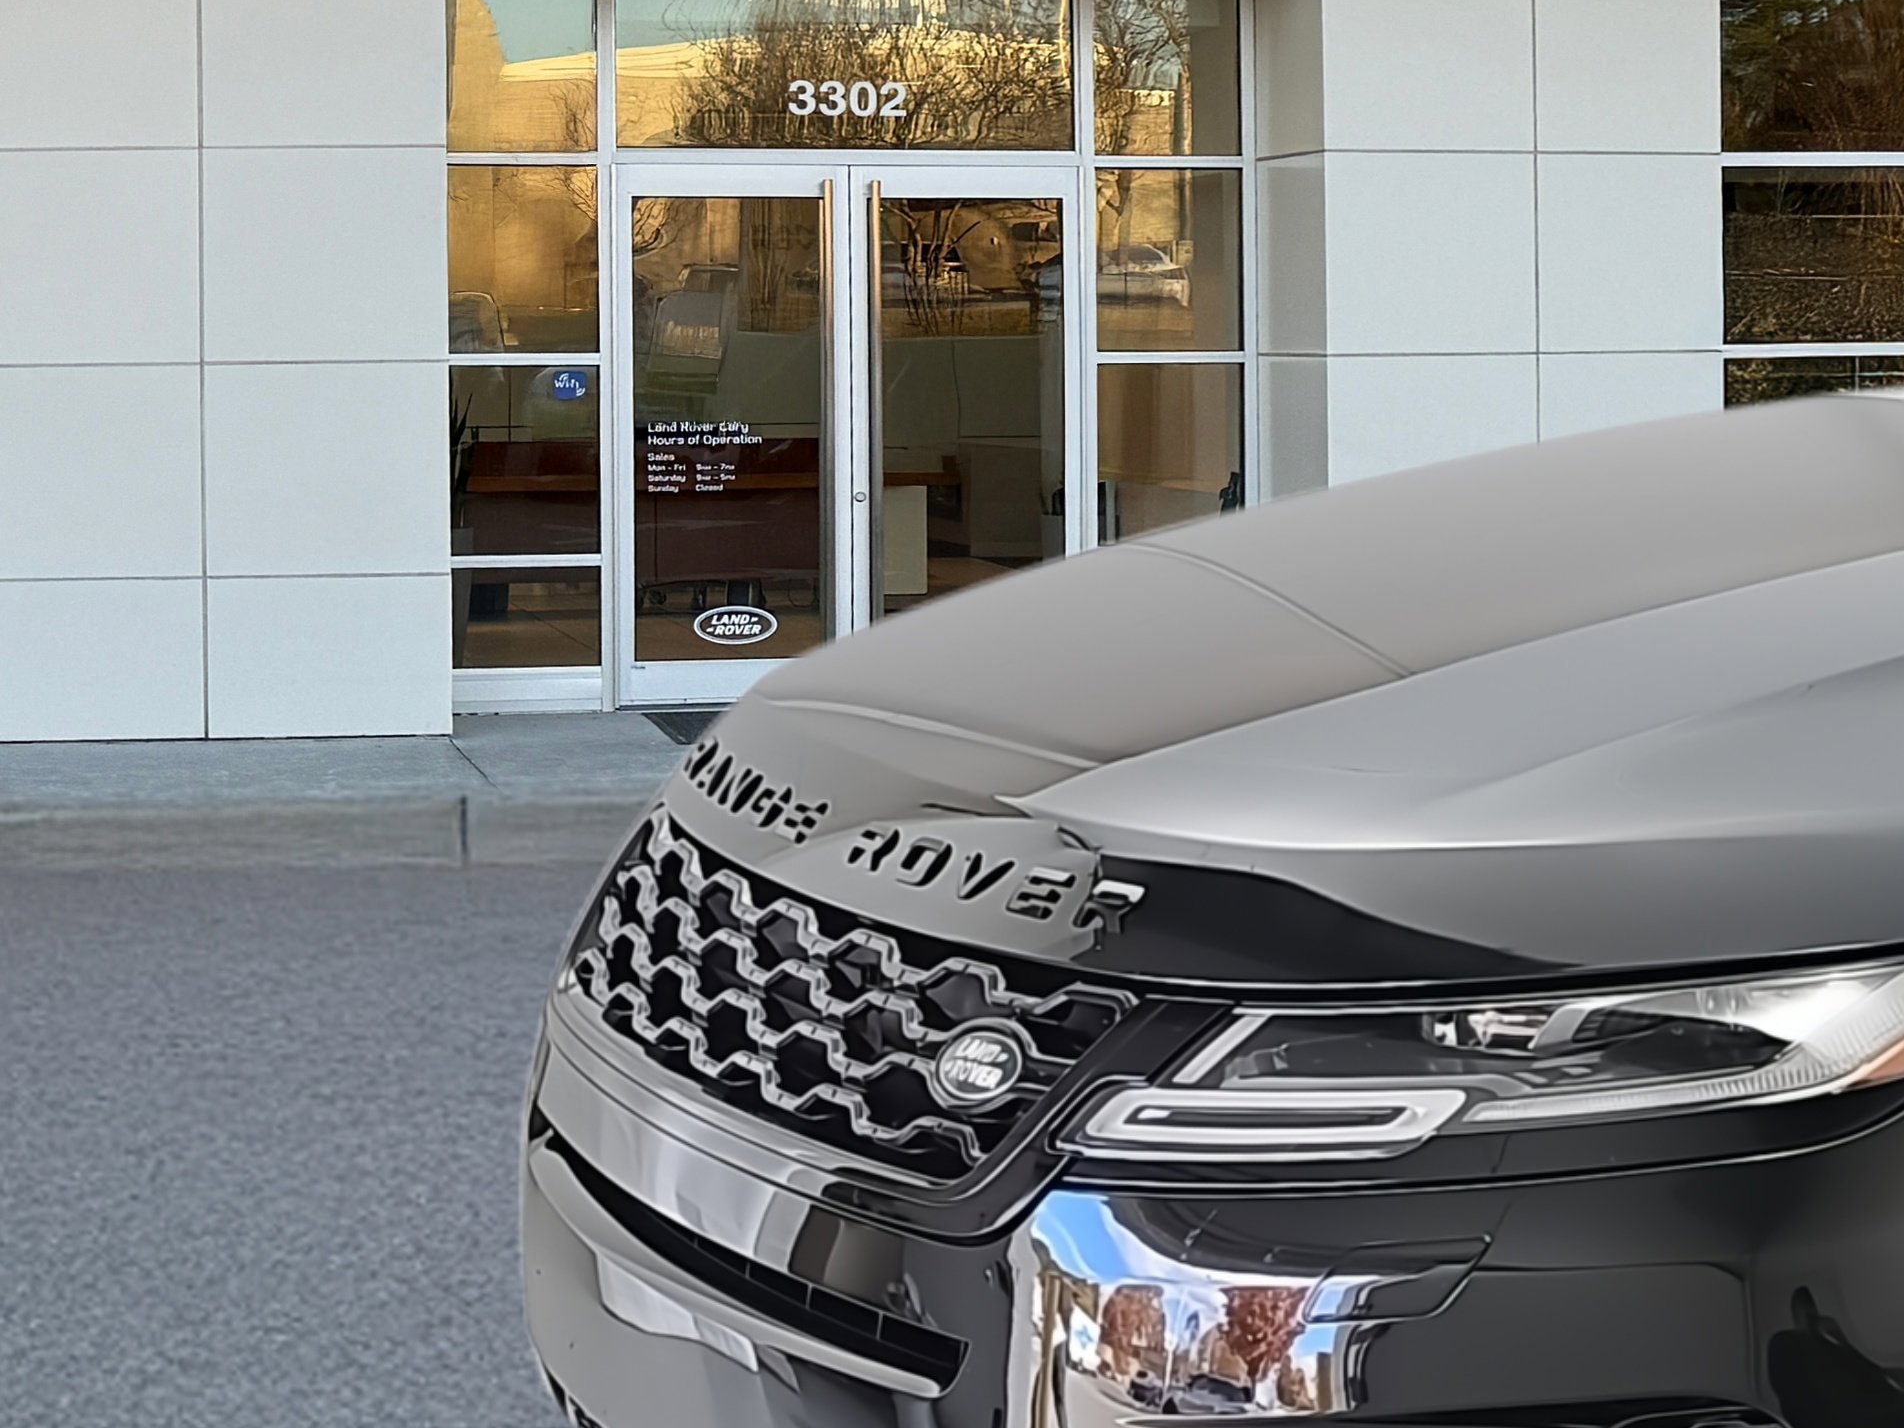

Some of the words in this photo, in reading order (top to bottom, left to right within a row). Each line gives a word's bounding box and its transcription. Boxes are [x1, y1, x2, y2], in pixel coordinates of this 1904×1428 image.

[788, 79, 908, 117] 3302
[647, 421, 678, 433] Land
[680, 421, 717, 433] Rover
[647, 435, 685, 446] Hours
[687, 434, 700, 446] of
[703, 435, 763, 447] Operation
[647, 452, 676, 462] Sales
[647, 474, 687, 483] Saturday
[647, 484, 680, 494] Sunday
[711, 614, 750, 625] LAND
[714, 624, 762, 636] ROVER
[684, 736, 830, 845] RANGE
[846, 827, 1147, 936] ROVER
